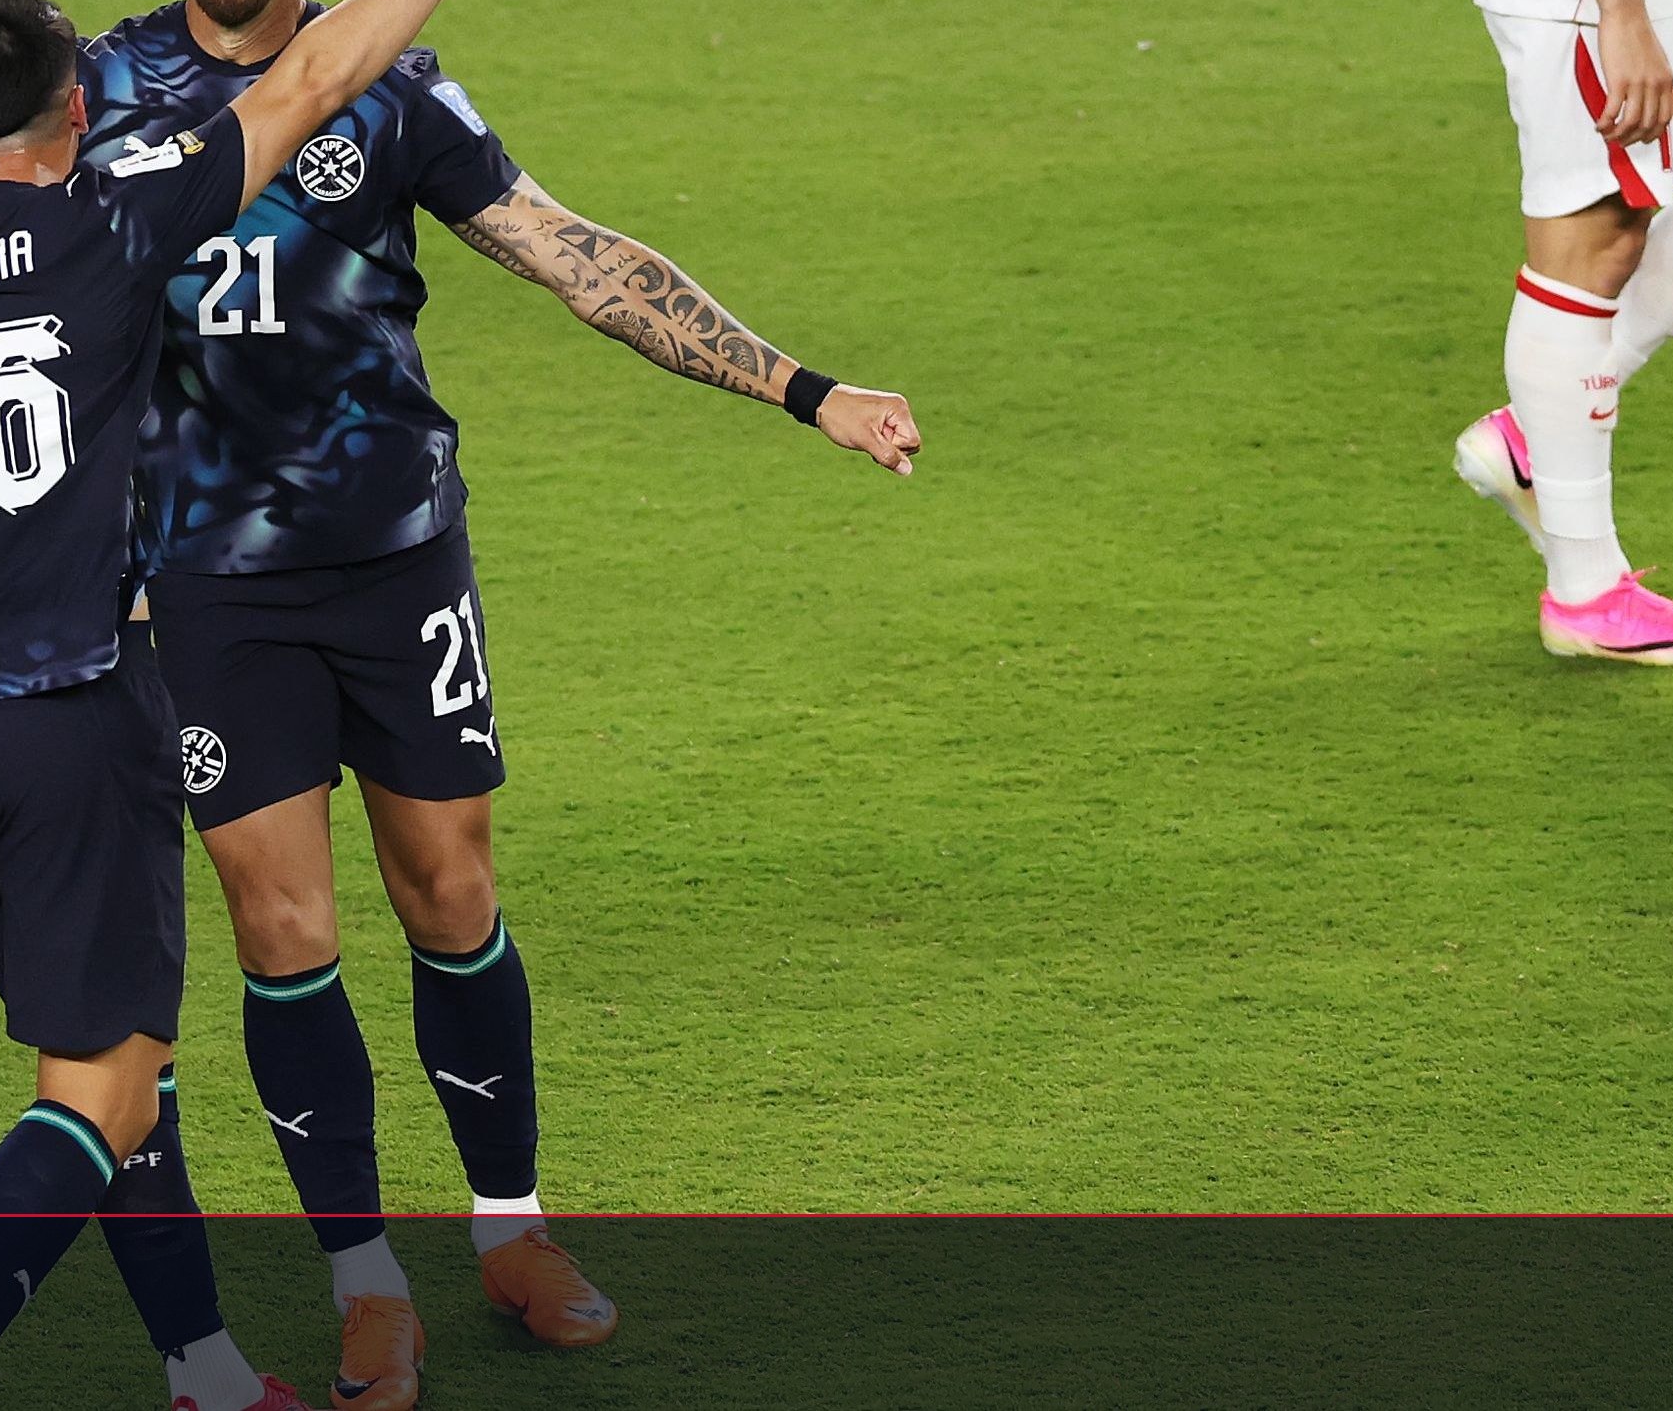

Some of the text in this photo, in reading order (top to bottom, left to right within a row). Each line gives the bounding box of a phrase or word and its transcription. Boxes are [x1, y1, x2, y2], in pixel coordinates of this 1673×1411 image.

[320, 140, 344, 152] APF
[197, 235, 286, 336] 21
[420, 590, 488, 717] 21
